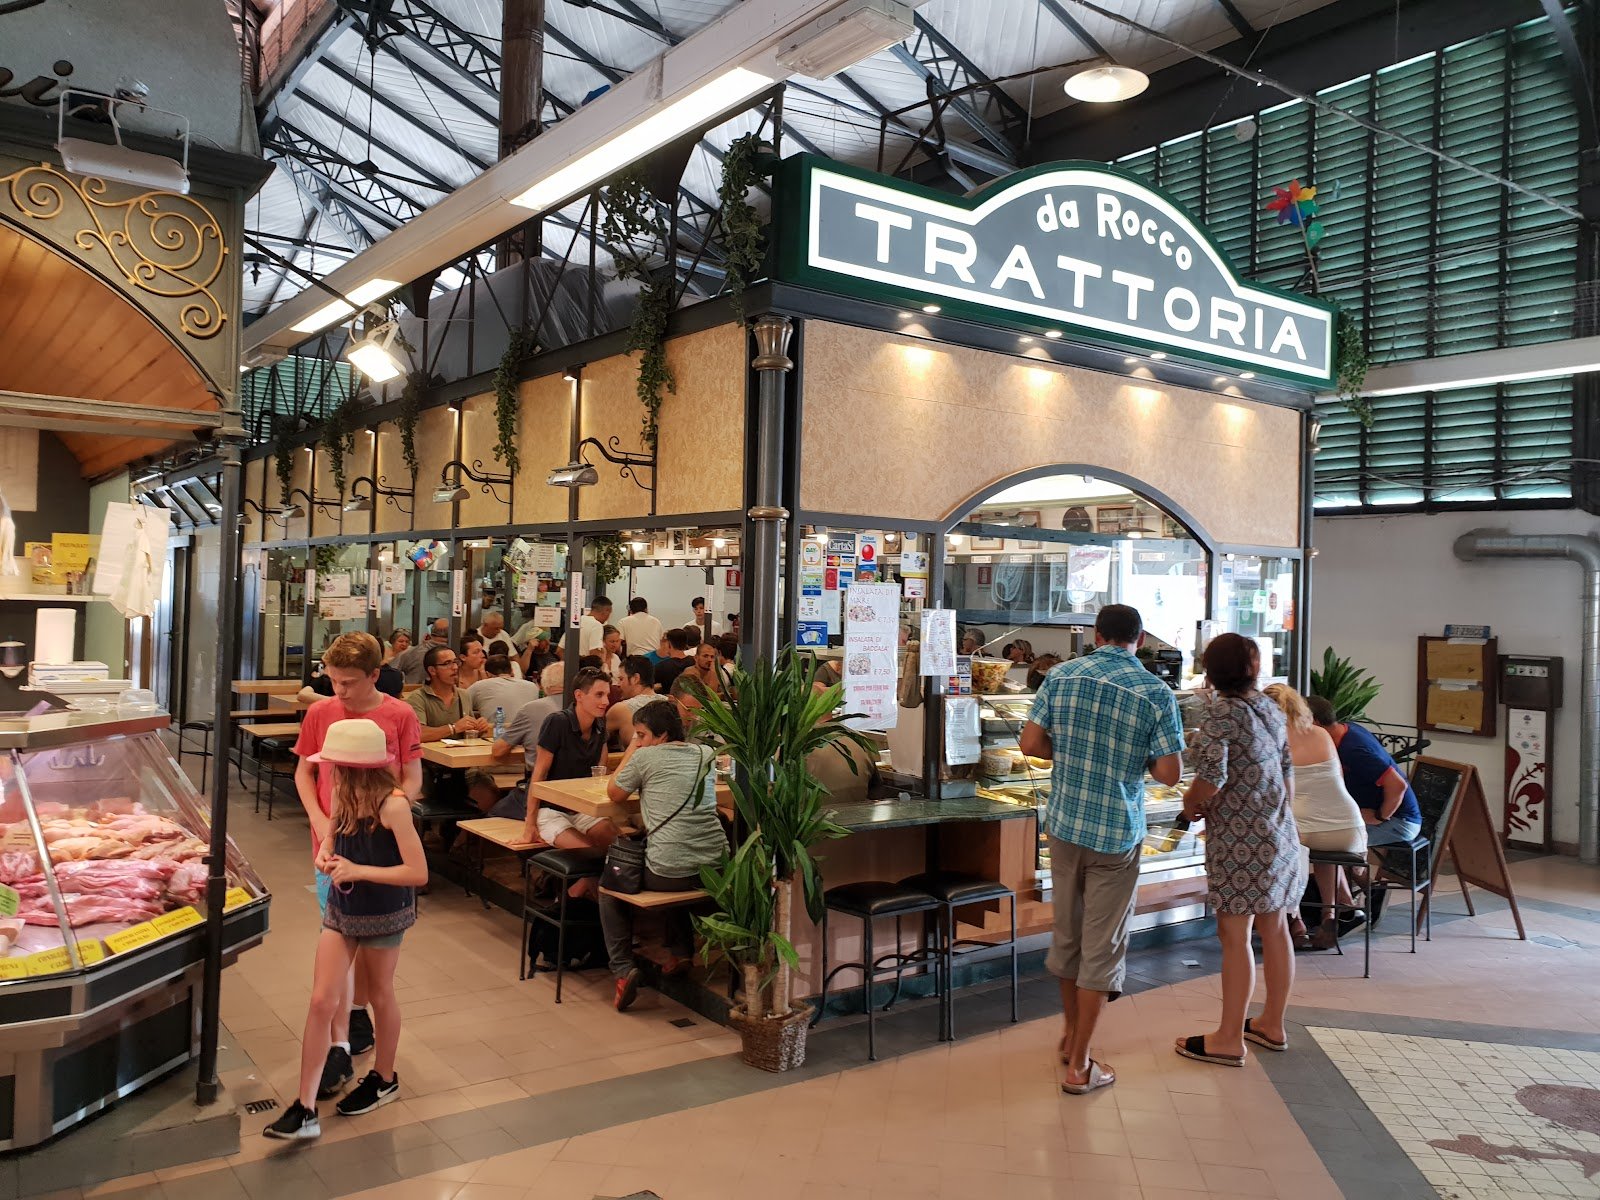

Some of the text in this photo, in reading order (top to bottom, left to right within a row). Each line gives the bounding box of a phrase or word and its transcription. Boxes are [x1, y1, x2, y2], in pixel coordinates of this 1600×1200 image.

[855, 202, 1307, 361] TRATTORIA
[1036, 193, 1193, 271] da Rocco
